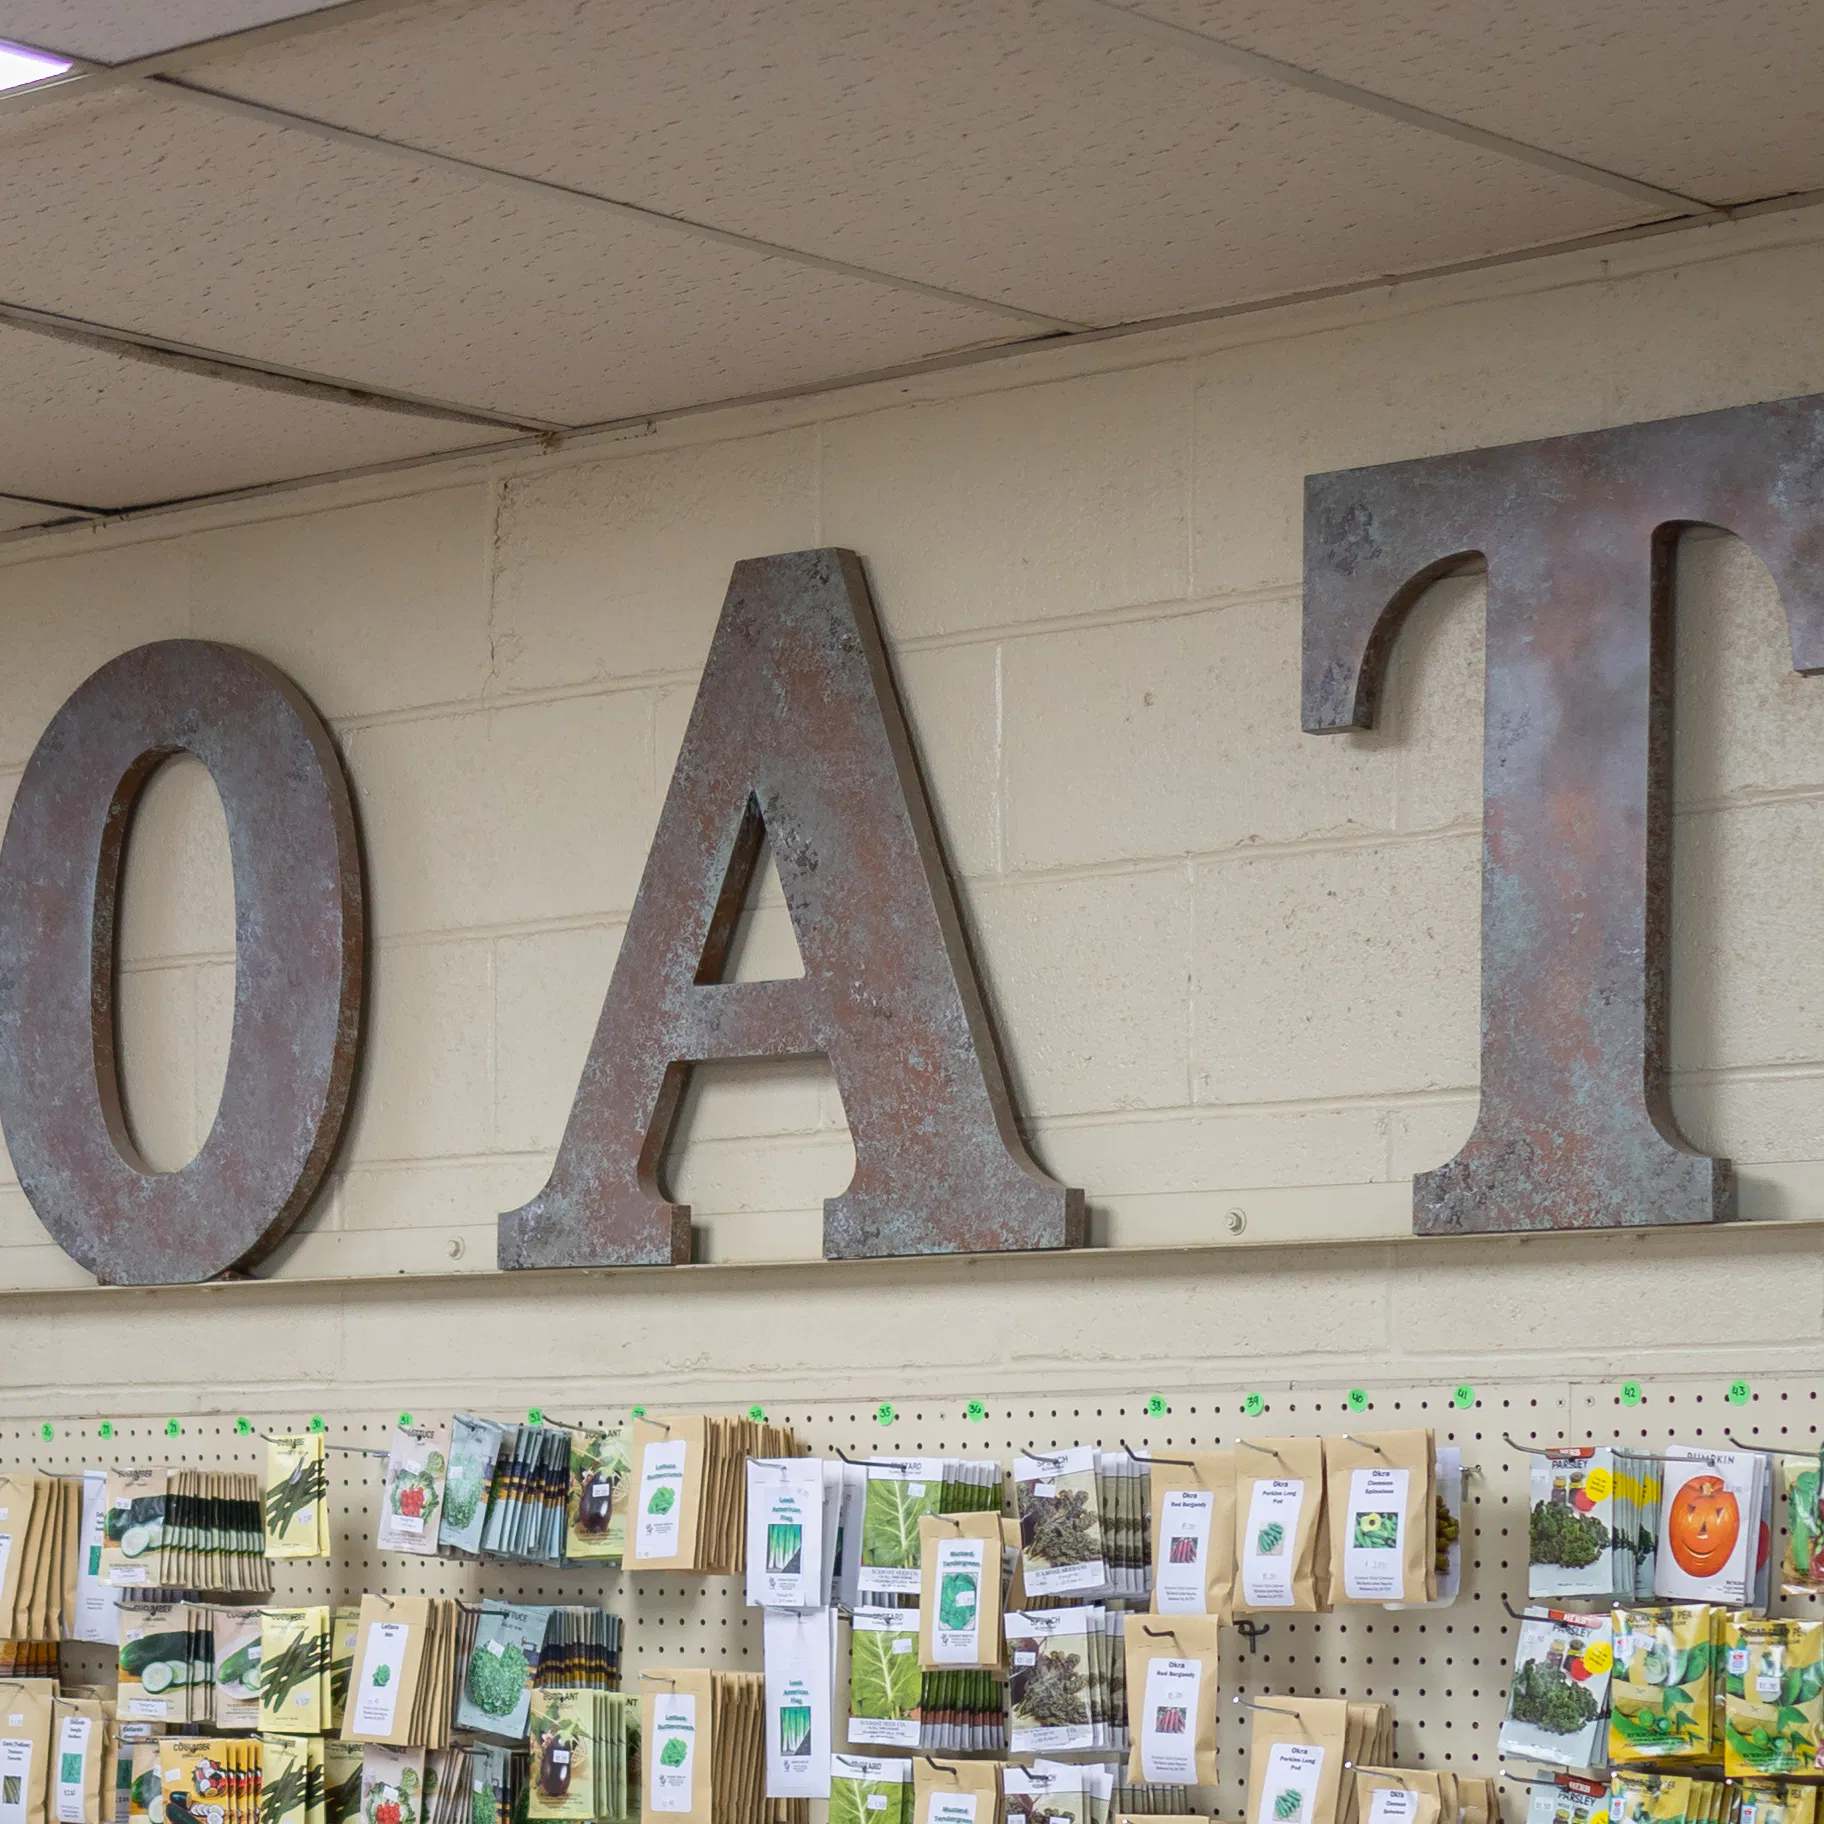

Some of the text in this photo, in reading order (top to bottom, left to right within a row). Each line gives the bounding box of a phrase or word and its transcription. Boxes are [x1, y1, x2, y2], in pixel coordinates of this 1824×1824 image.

[1551, 1459, 1588, 1470] PARSLEY
[1182, 1491, 1198, 1500] Okra
[1168, 1661, 1186, 1669] Okra
[1291, 1746, 1309, 1755] Okra
